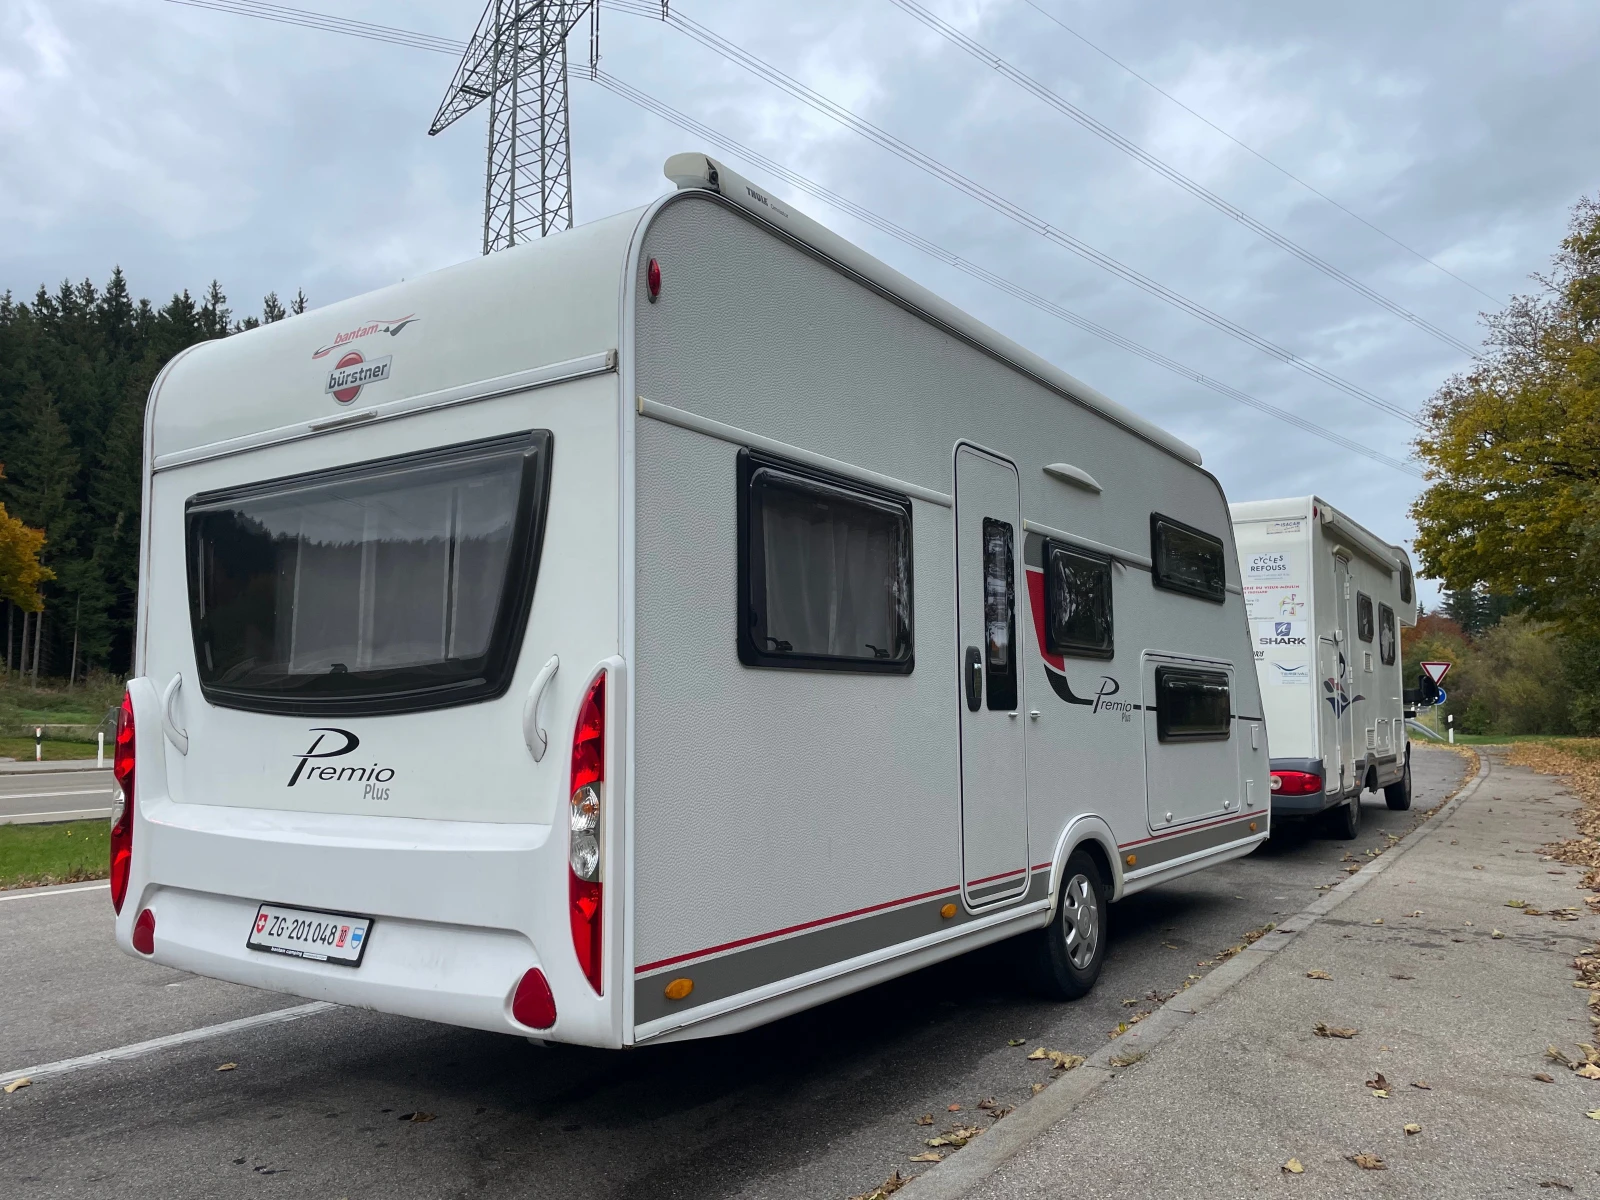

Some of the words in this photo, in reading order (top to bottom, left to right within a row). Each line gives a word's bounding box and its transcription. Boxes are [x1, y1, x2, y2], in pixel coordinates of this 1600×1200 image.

[745, 186, 769, 207] THULE
[333, 323, 379, 345] bantam
[328, 363, 388, 389] bürstner
[1250, 564, 1287, 572] REFOUSS
[1253, 555, 1284, 565] CYCLES
[1259, 637, 1306, 645] SHARK
[1093, 675, 1132, 714] Premio
[1121, 712, 1131, 722] Plus
[287, 727, 395, 787] Premio
[362, 782, 390, 801] Plus
